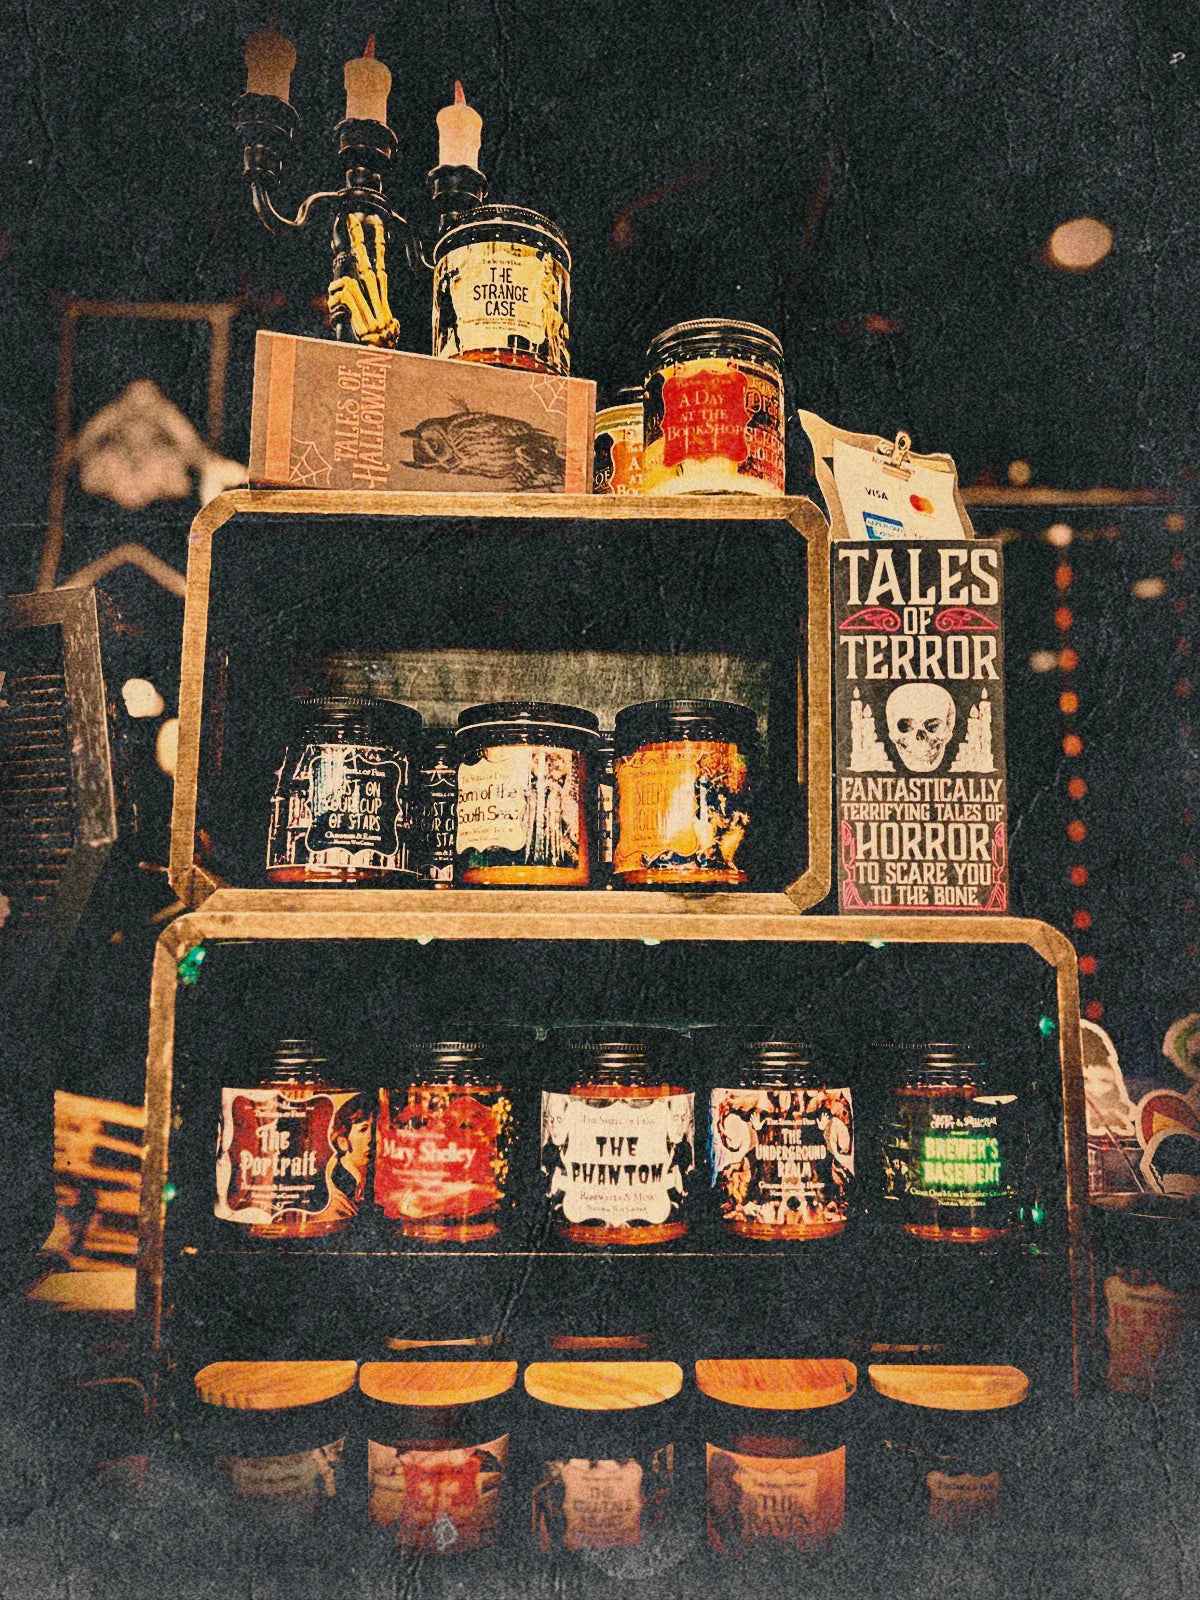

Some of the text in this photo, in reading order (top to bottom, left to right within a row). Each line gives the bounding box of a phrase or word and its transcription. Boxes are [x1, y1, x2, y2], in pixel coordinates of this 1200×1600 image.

[490, 267, 512, 283] THE
[473, 284, 529, 303] STRANGE
[485, 301, 516, 317] CASE
[335, 365, 361, 461] TALES OF
[352, 347, 392, 489] HALLOWEEN
[865, 487, 889, 501] VISA
[838, 549, 999, 605] TALES
[903, 607, 935, 635] OF
[840, 635, 1000, 680] TERROR
[365, 782, 381, 797] ON
[841, 777, 1003, 802] FANTASTICALLY
[360, 798, 382, 814] CUP
[841, 803, 1004, 821] TERRIFYING TALES OF
[328, 813, 381, 831] OF STARS
[854, 822, 992, 861] HORROR
[855, 862, 992, 886] TO SCARE YOU
[870, 885, 979, 906] TO THE BONE
[256, 1118, 290, 1152] The
[782, 1128, 802, 1145] THE
[383, 1138, 477, 1168] Mary Shelley
[596, 1136, 639, 1157] THE
[755, 1145, 827, 1160] UNDERGROUND
[924, 1138, 999, 1160] BREWER'S
[239, 1151, 318, 1185] Portrait
[572, 1162, 664, 1185] PHANTOM
[924, 1161, 1002, 1184] BASEMENT
